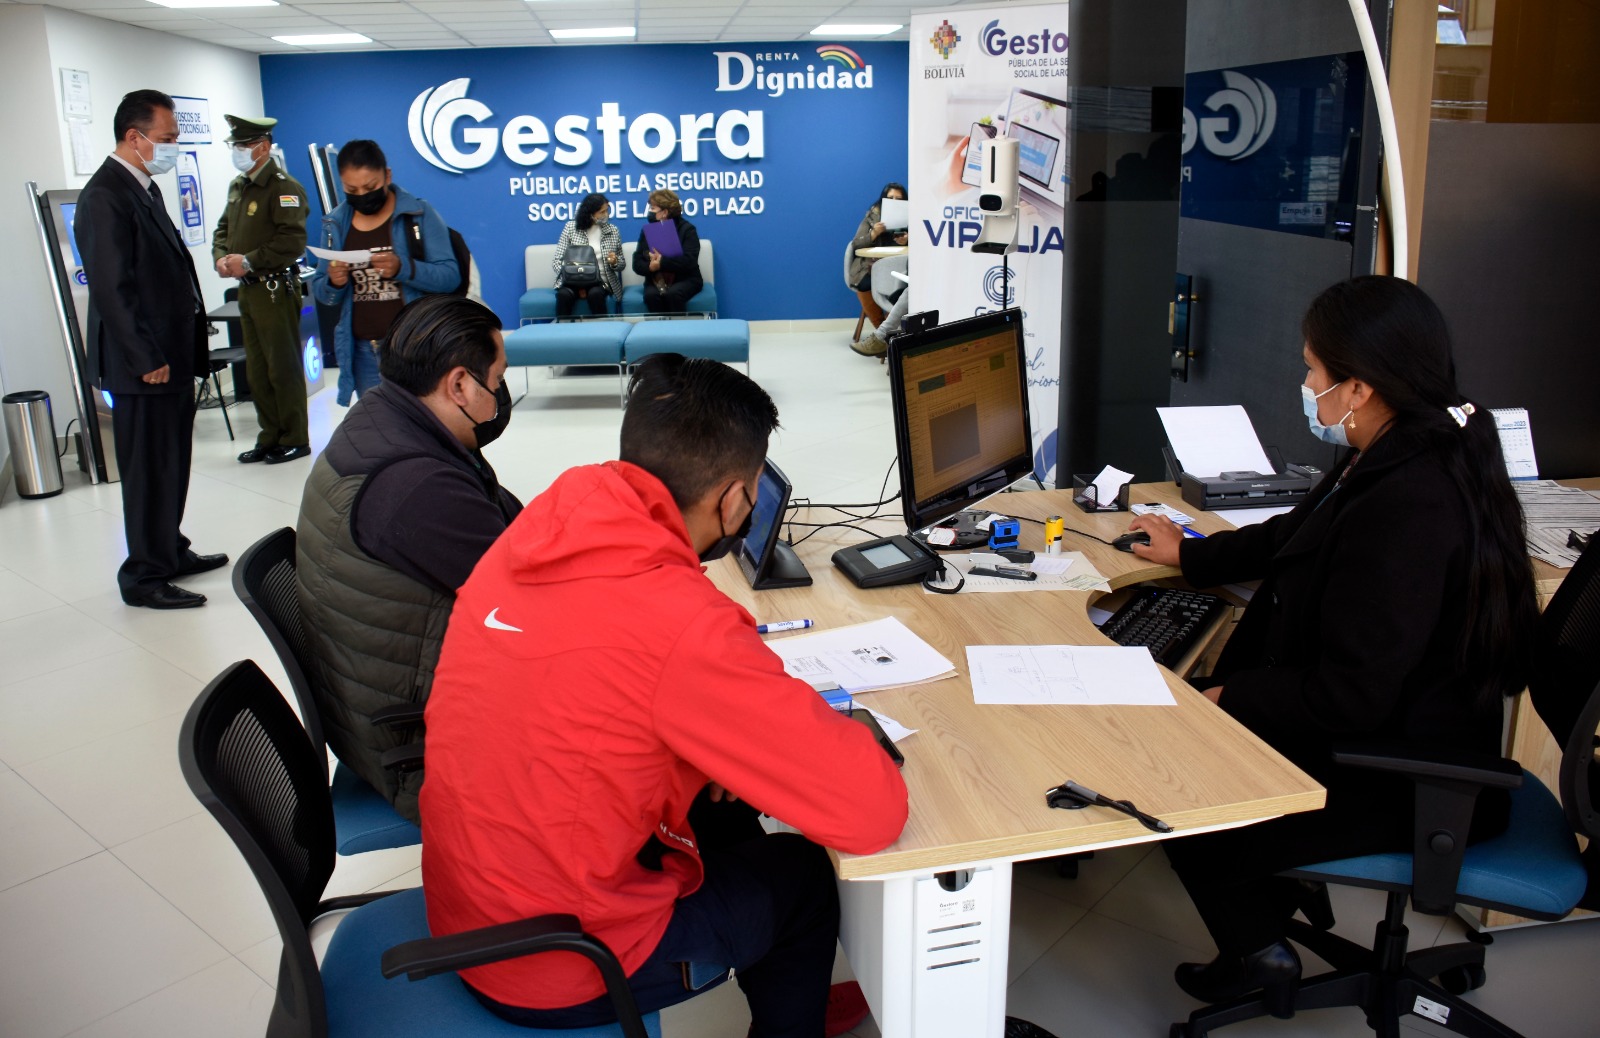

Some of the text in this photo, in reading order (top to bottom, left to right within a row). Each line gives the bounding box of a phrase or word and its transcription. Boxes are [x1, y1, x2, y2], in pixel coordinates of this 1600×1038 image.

[755, 52, 800, 62] RENTA
[1008, 58, 1038, 67] PÚBLICA
[1039, 58, 1048, 67] DE
[1049, 58, 1059, 66] LA
[713, 51, 873, 97] Dignidad
[924, 67, 965, 79] BOLIVIA
[1014, 69, 1039, 78] SOCIAL
[1040, 69, 1050, 78] DE
[194, 113, 201, 122] DE
[432, 98, 764, 170] Gestora
[510, 170, 764, 195] PÚBLICA DE LA SEGURIDAD
[703, 196, 765, 216] PLAZO
